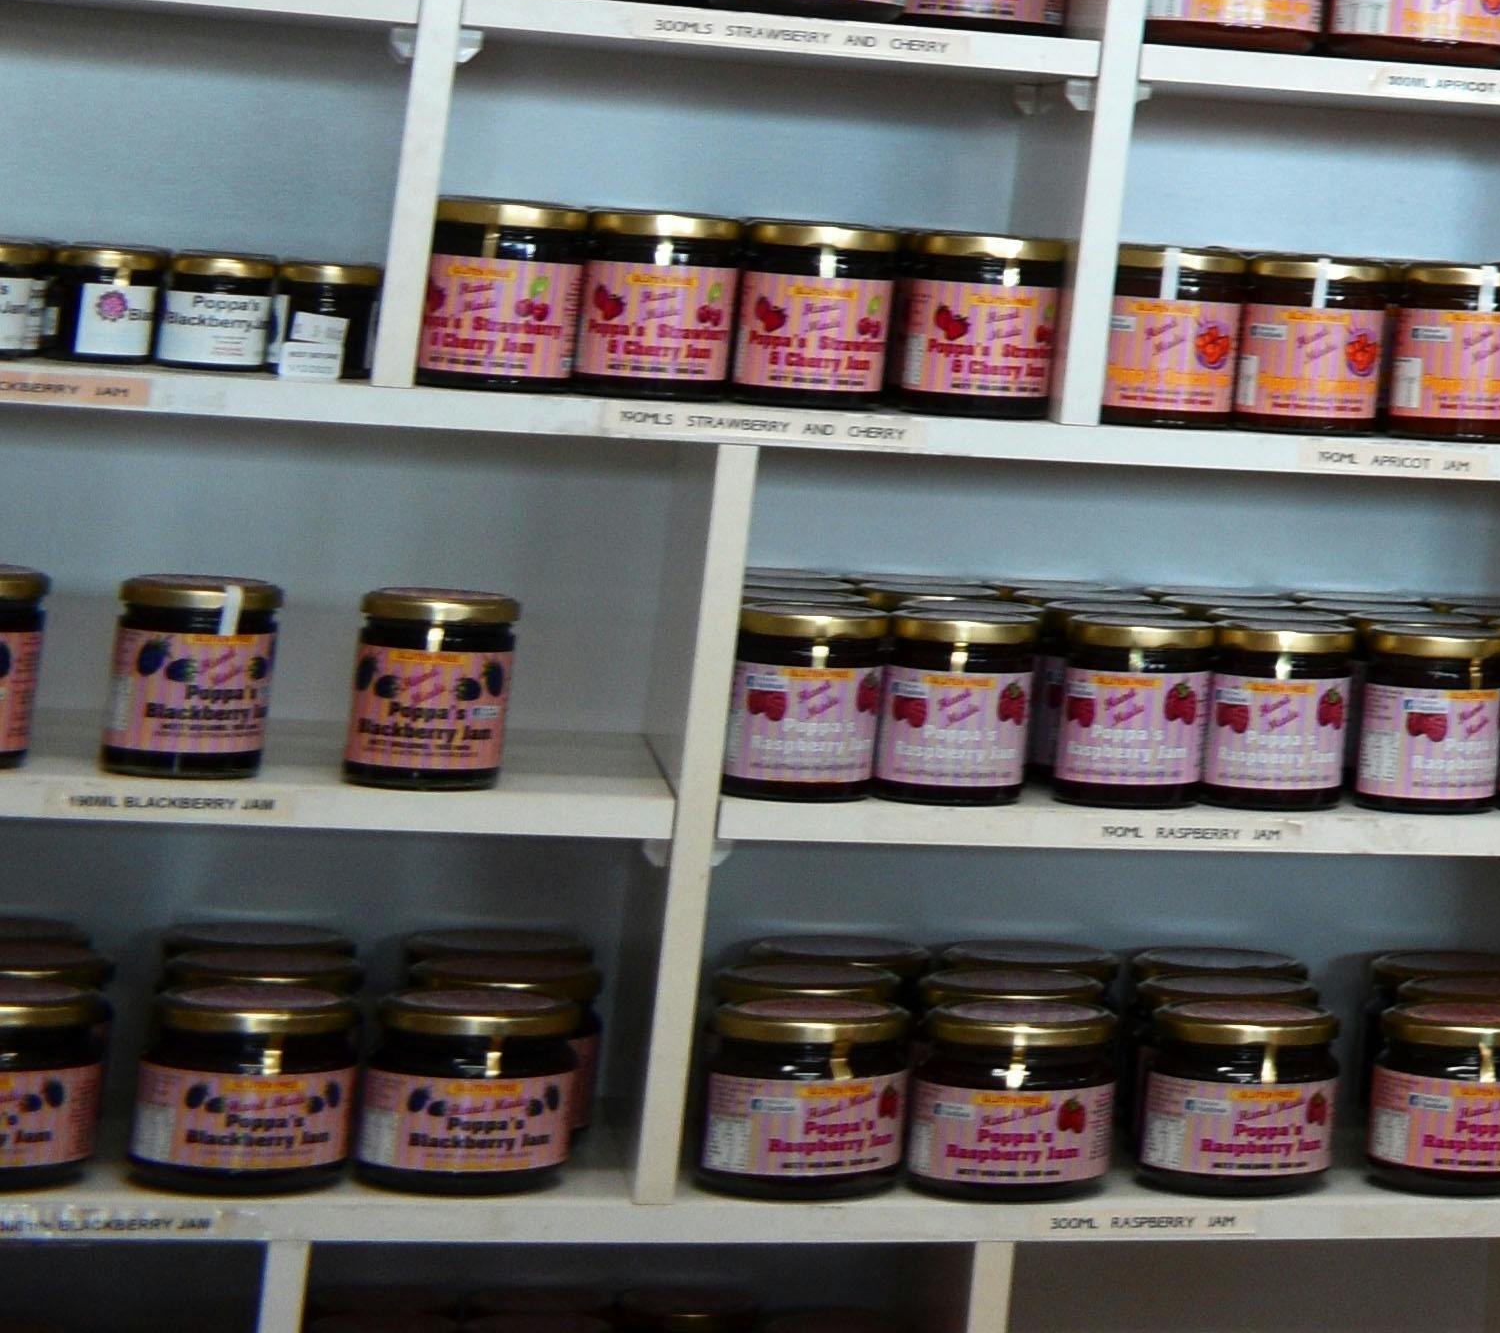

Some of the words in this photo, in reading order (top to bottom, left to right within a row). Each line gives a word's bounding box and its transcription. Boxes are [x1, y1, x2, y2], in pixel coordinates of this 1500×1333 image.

[726, 24, 832, 44] STRAWBERRY
[846, 35, 878, 49] AND
[890, 38, 948, 55] CHERRY
[1436, 78, 1496, 93] APRICOT
[686, 415, 790, 433] STRAWBERRY
[803, 423, 834, 437] AND
[847, 424, 907, 440] CHERRY
[1371, 454, 1432, 470] APRICOT
[1442, 458, 1472, 472] JAM
[124, 795, 237, 811] BLACKBERRY
[1156, 826, 1240, 840] RASPBERRY
[1252, 828, 1281, 841] JAM
[1110, 1217, 1197, 1229] RASPBERRY
[1208, 1216, 1237, 1229] JAM
